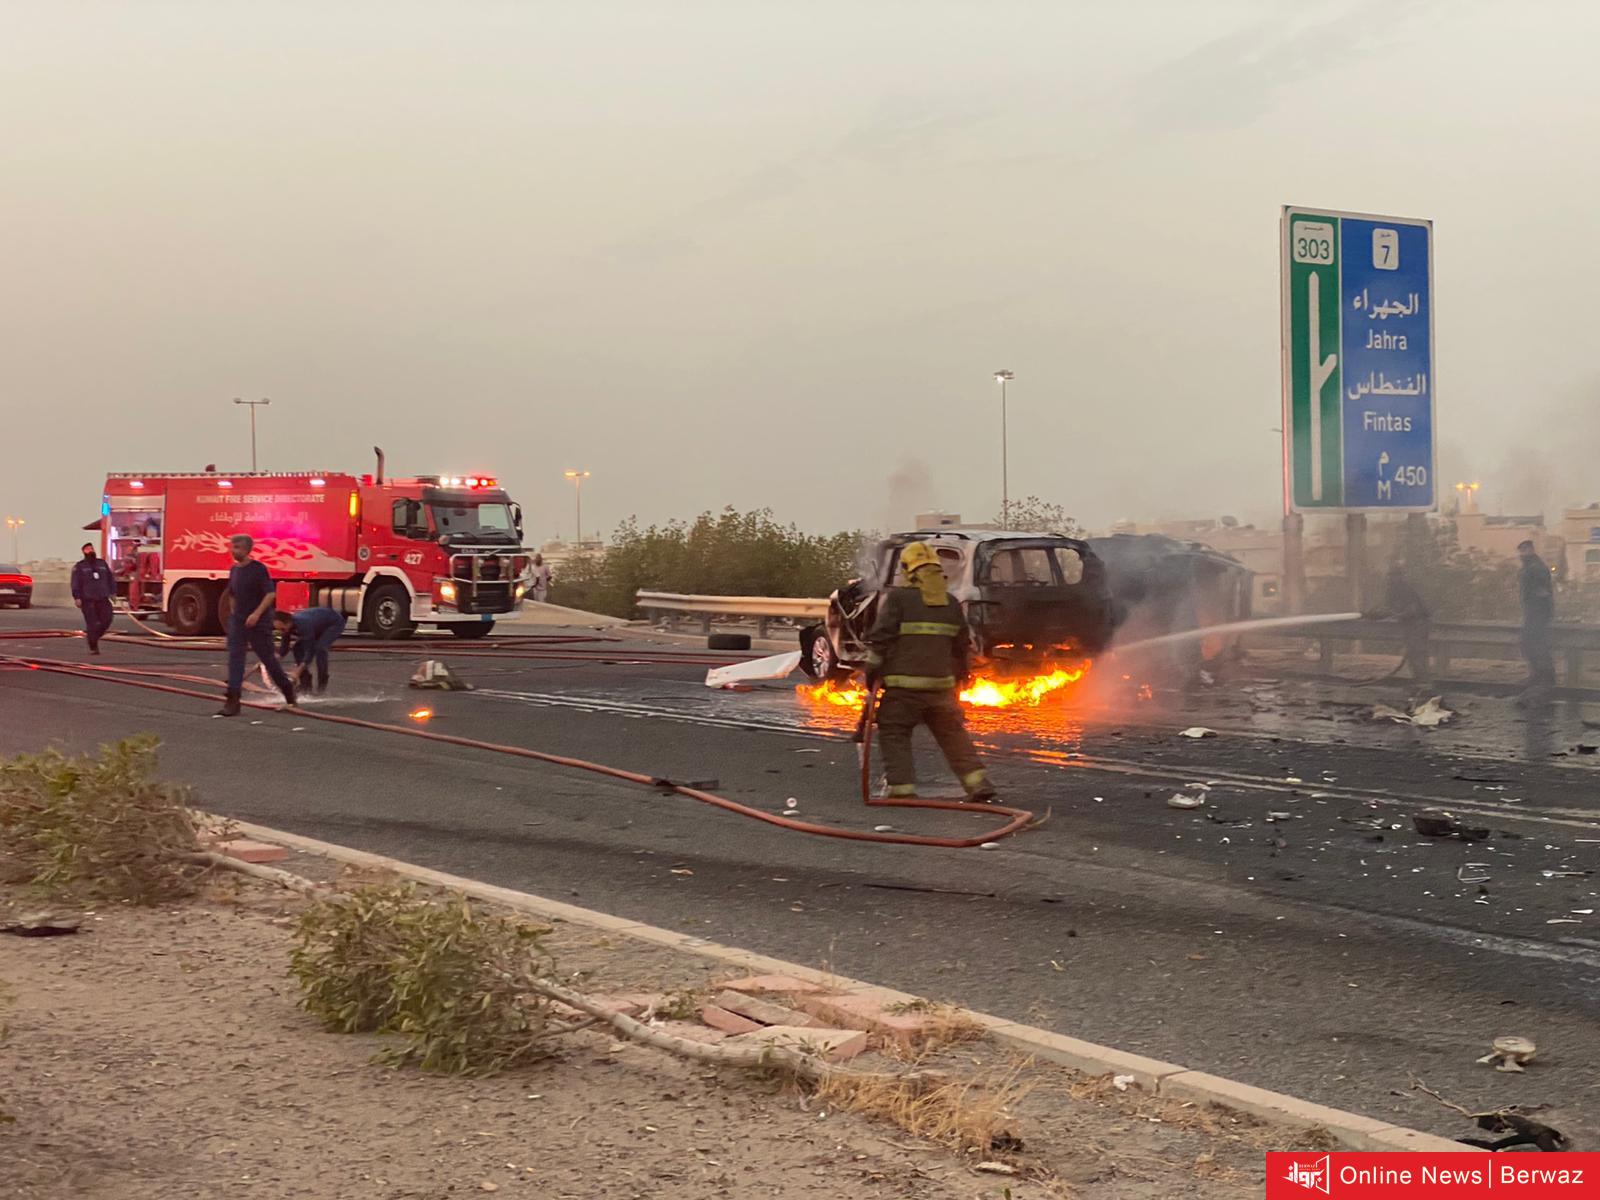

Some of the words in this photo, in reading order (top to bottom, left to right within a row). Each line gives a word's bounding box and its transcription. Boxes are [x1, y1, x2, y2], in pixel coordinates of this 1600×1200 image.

[1297, 238, 1330, 260] 303
[1381, 245, 1391, 265] 7
[1352, 287, 1419, 320] الجهراء
[1366, 329, 1408, 350] Jahra
[1348, 369, 1427, 400] الفنطاس
[1363, 411, 1412, 432] Fintas
[1378, 451, 1390, 477] م
[1394, 466, 1427, 486] 450
[1377, 480, 1392, 500] M
[404, 553, 424, 565] 427
